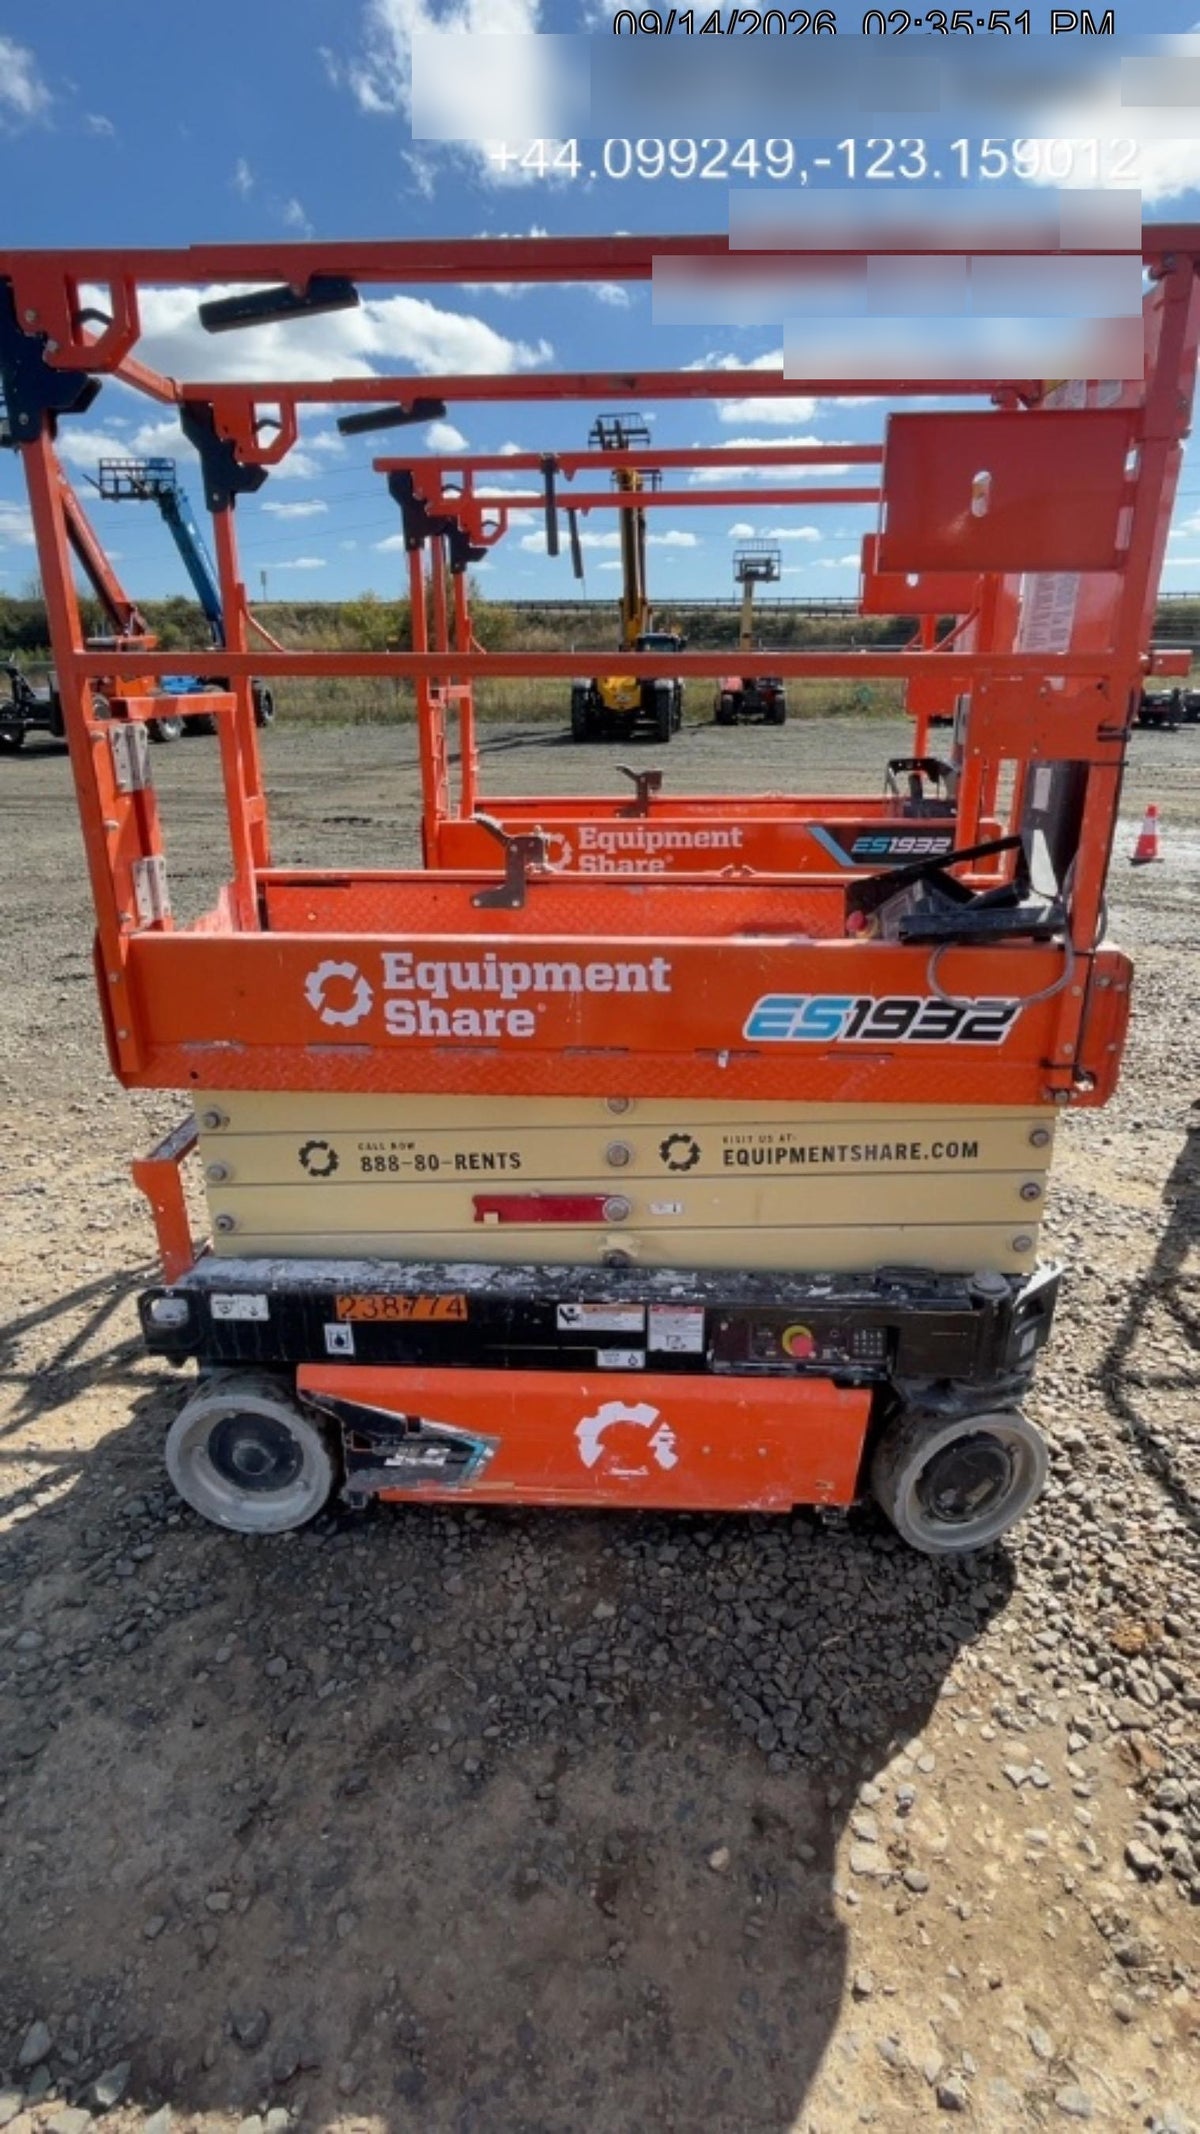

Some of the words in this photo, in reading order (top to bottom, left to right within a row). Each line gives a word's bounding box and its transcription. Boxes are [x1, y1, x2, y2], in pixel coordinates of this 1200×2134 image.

[578, 826, 743, 854] Equipment
[851, 836, 952, 854] ES1932
[578, 853, 666, 873] Share
[381, 952, 672, 999] Equipment
[383, 999, 536, 1037] Share
[743, 993, 1023, 1045] ES1932
[358, 1142, 386, 1151] CALL
[758, 1134, 773, 1143] US
[360, 1152, 522, 1172] 888-80-RENTS
[723, 1141, 979, 1167] EQUIPMENTSHARE.COM
[339, 1296, 463, 1318] 238774
